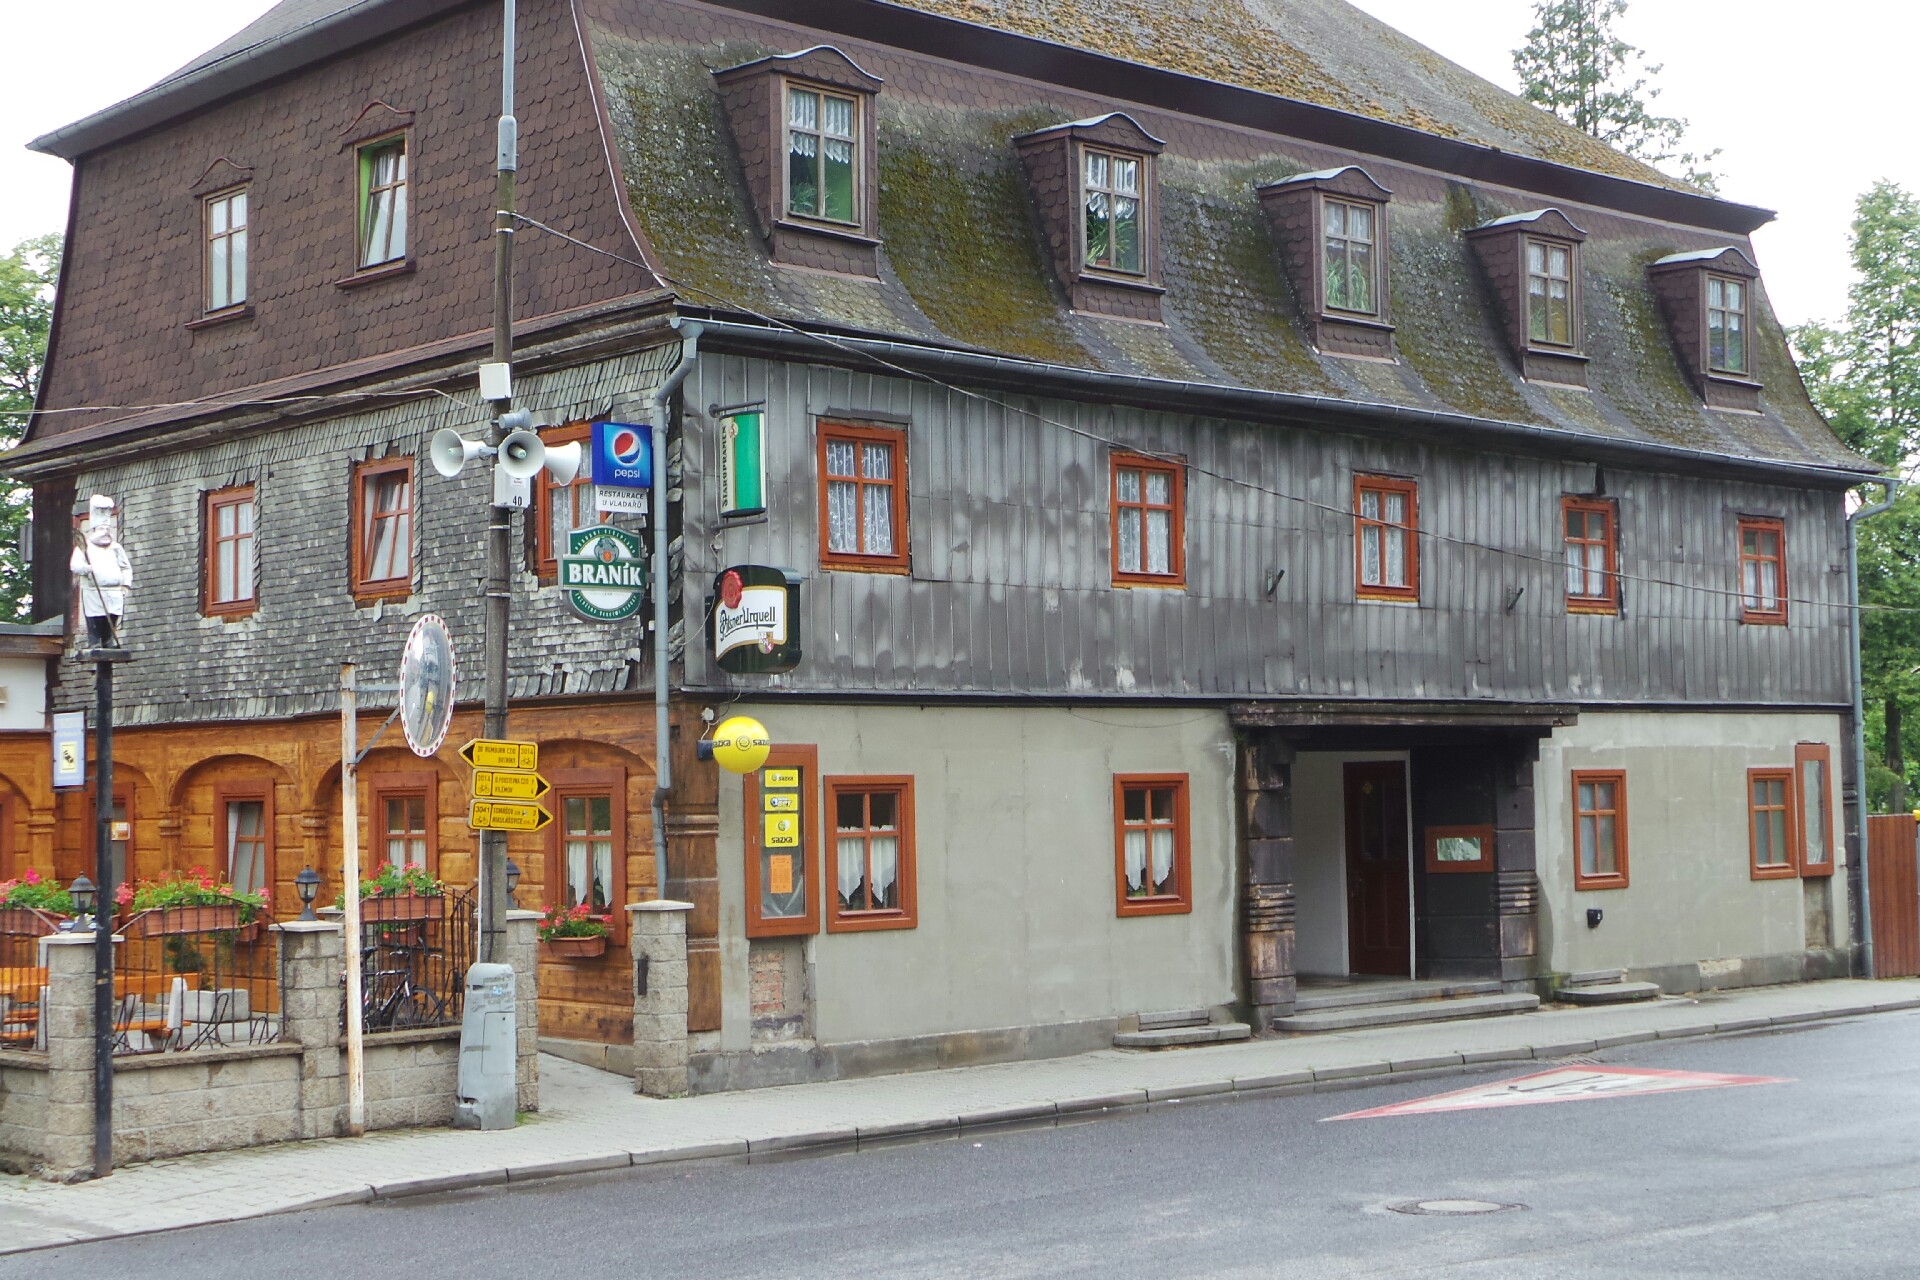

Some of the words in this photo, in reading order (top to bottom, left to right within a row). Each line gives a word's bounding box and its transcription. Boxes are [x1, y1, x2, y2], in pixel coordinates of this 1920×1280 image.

[721, 425, 729, 509] STAROPRAMEN
[614, 468, 640, 479] pepsi
[599, 490, 645, 500] RESTAURACE
[512, 495, 523, 507] 40
[568, 562, 642, 586] BRANÍK
[719, 609, 743, 642] Pilsner
[742, 606, 776, 631] Urquell
[712, 740, 731, 748] azka
[475, 805, 490, 813] 3041
